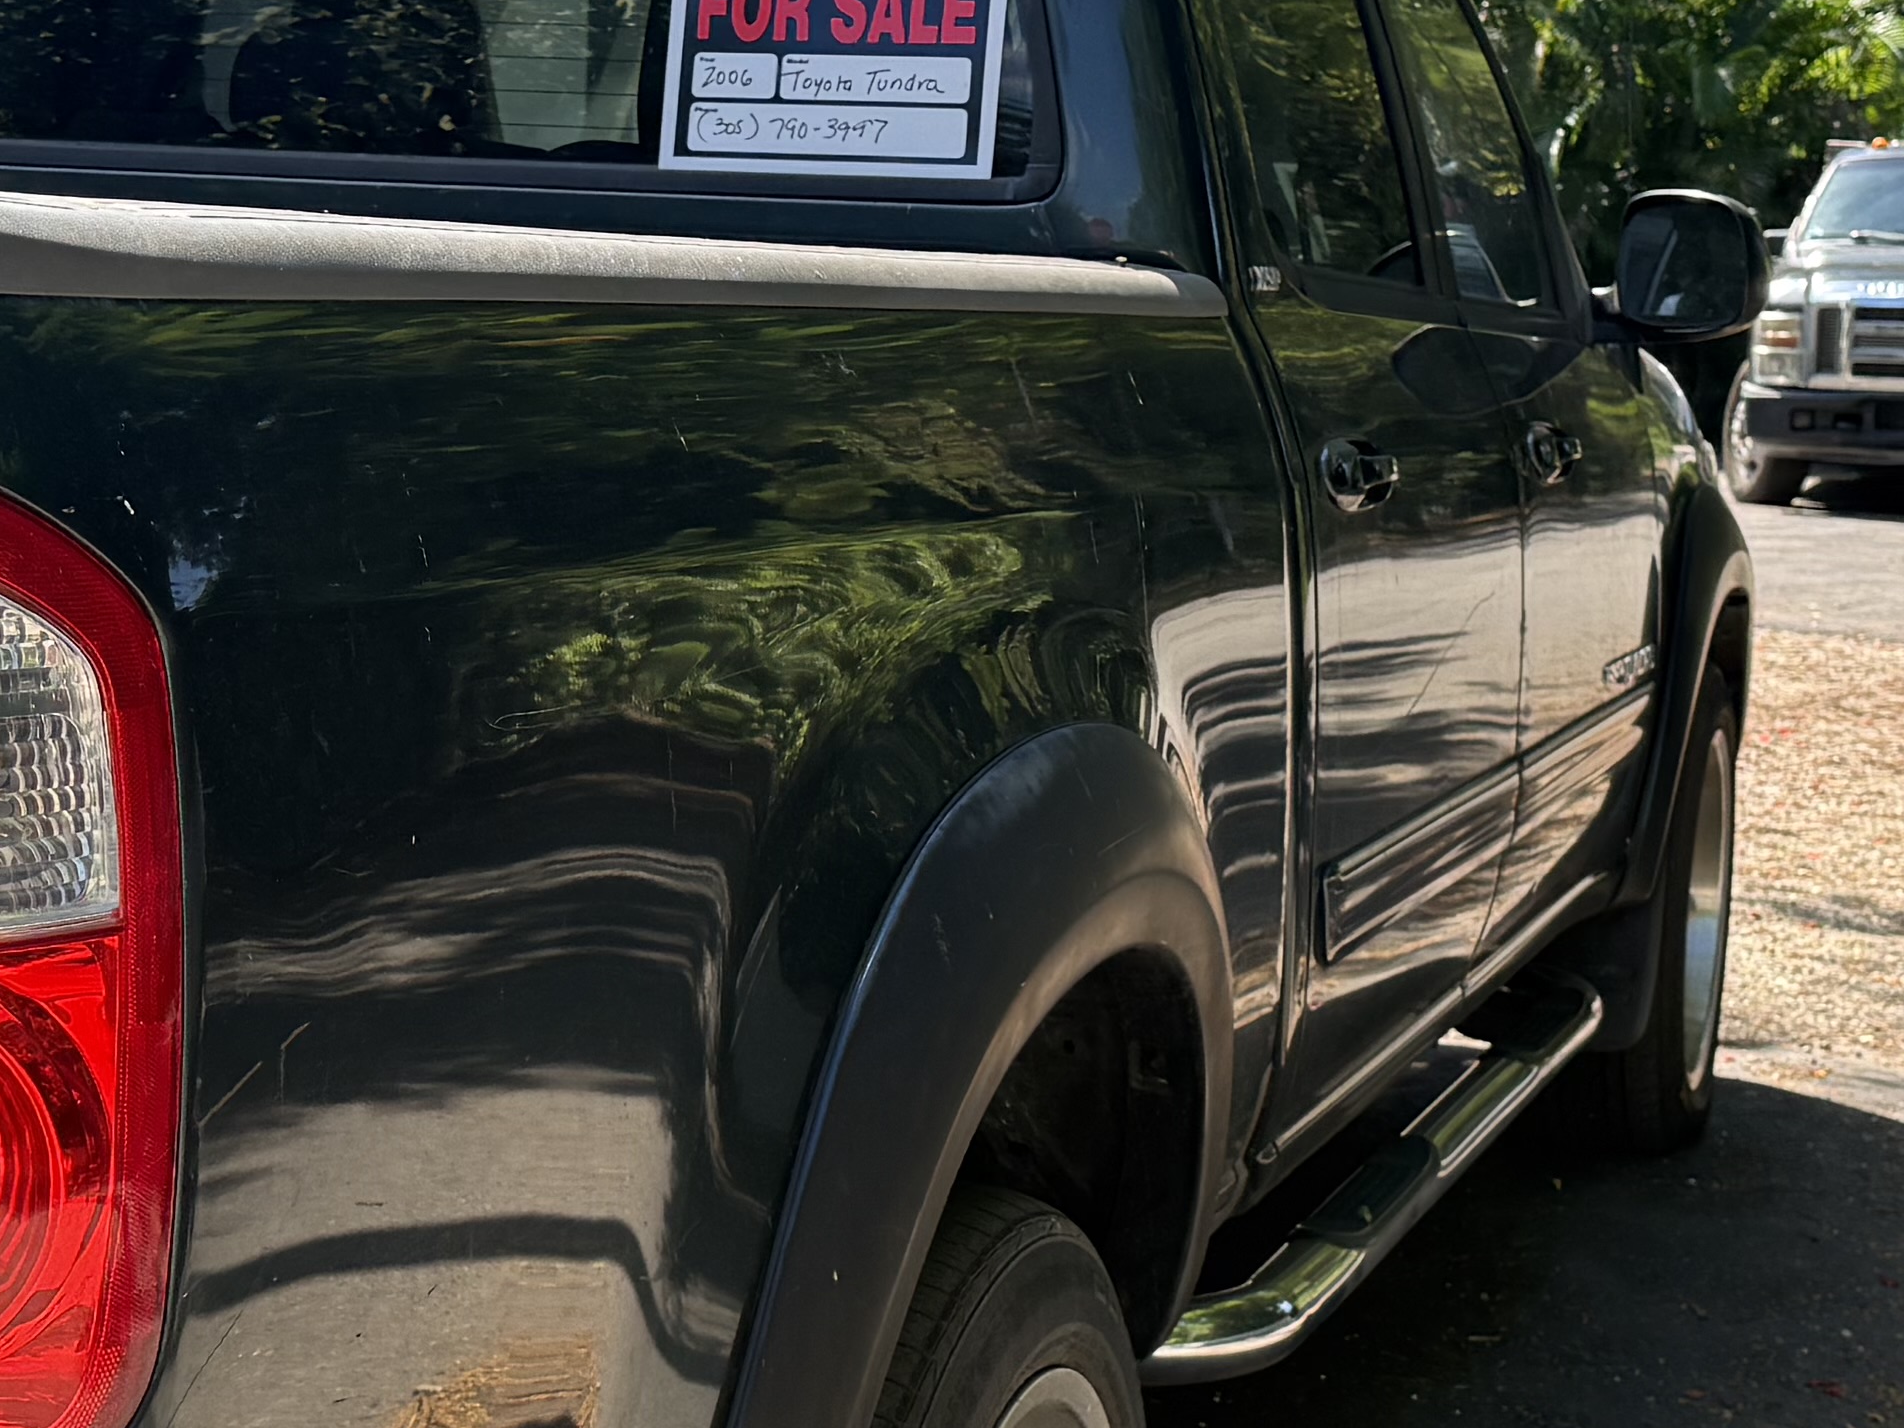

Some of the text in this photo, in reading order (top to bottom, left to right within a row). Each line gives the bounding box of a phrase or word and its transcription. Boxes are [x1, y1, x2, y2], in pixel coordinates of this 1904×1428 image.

[701, 66, 753, 88] 2006
[781, 69, 946, 97] Toyota Tundra
[696, 110, 759, 142] (305)
